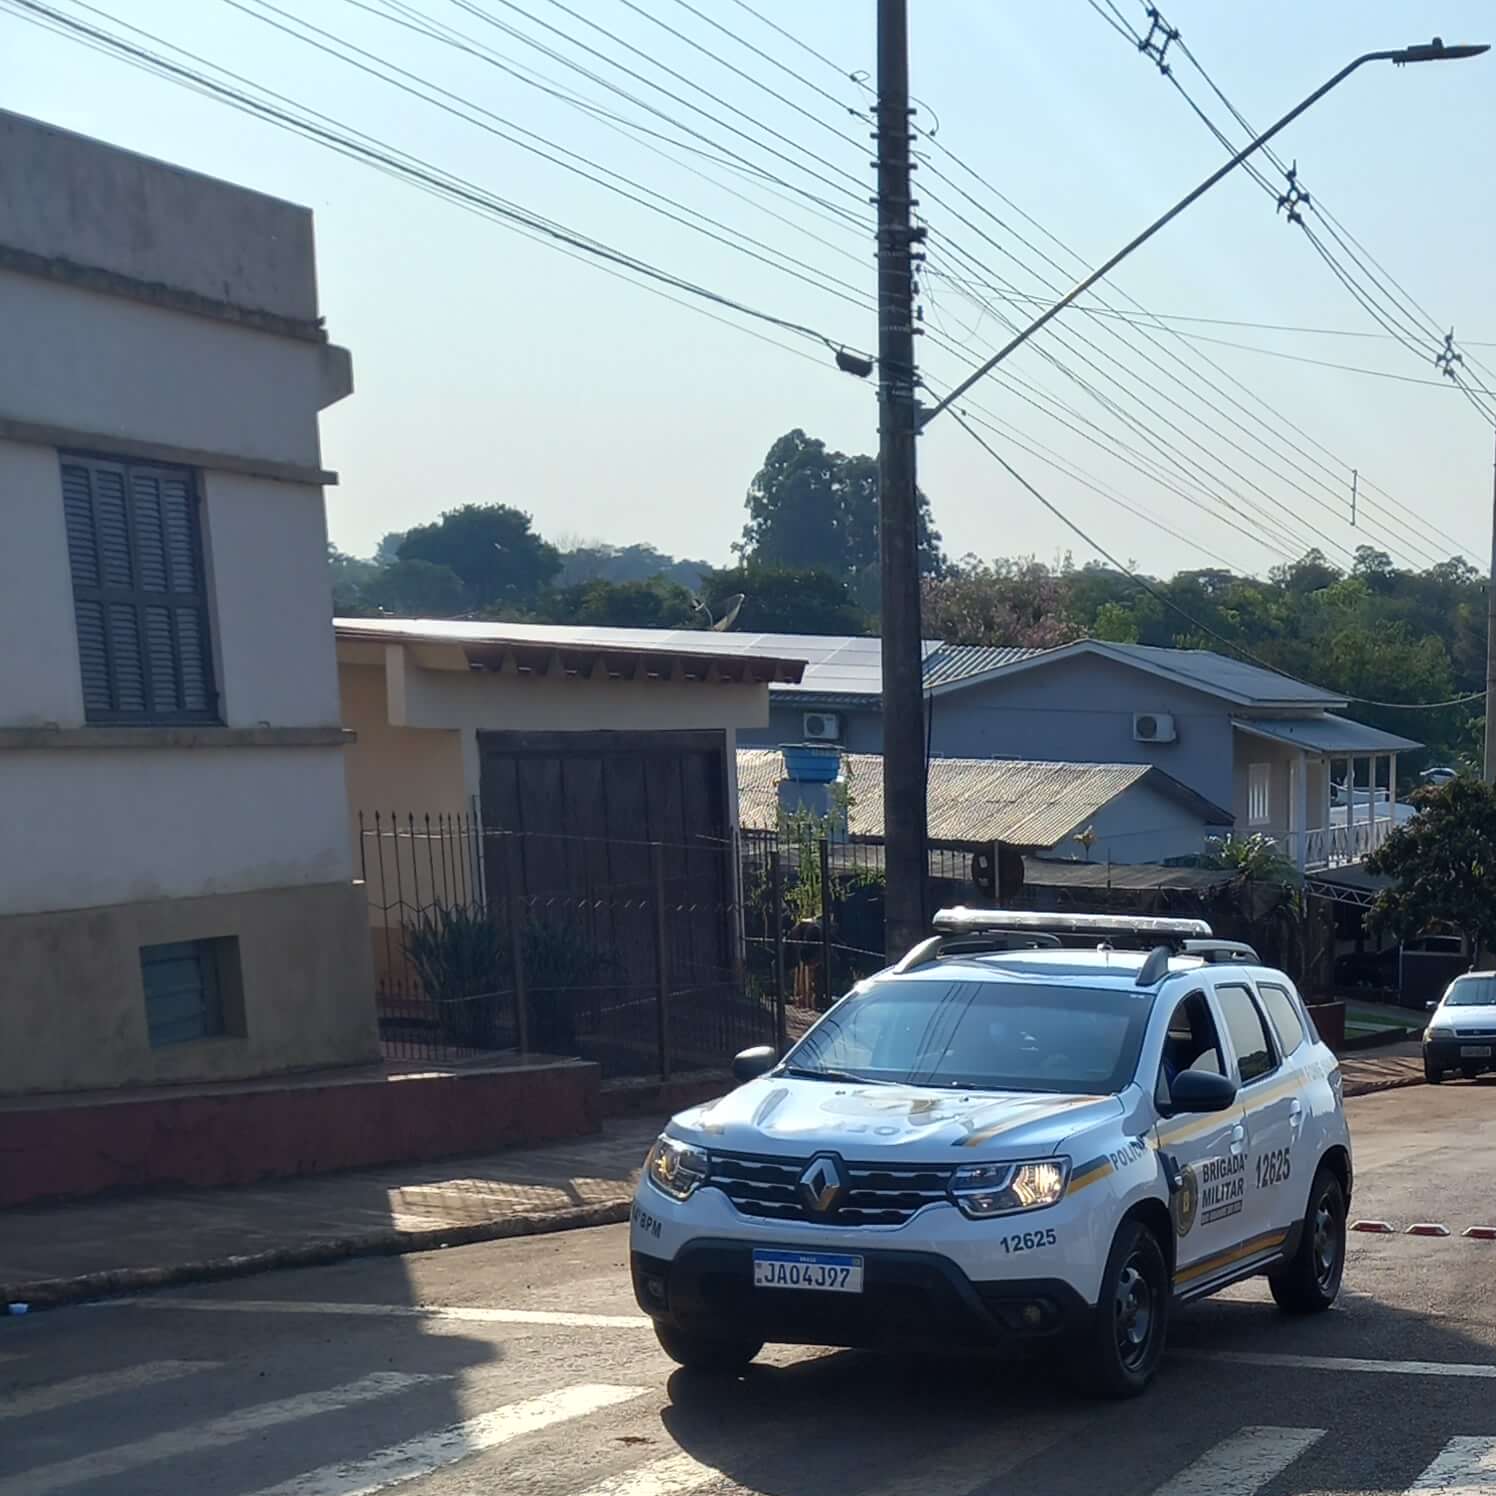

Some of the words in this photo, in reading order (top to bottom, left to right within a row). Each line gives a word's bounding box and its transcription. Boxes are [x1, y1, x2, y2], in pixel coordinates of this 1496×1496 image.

[1202, 1153, 1245, 1183] BRIGADA
[1256, 1147, 1290, 1189] 12625
[1202, 1178, 1243, 1208] MILITAR
[1001, 1228, 1057, 1254] 12625
